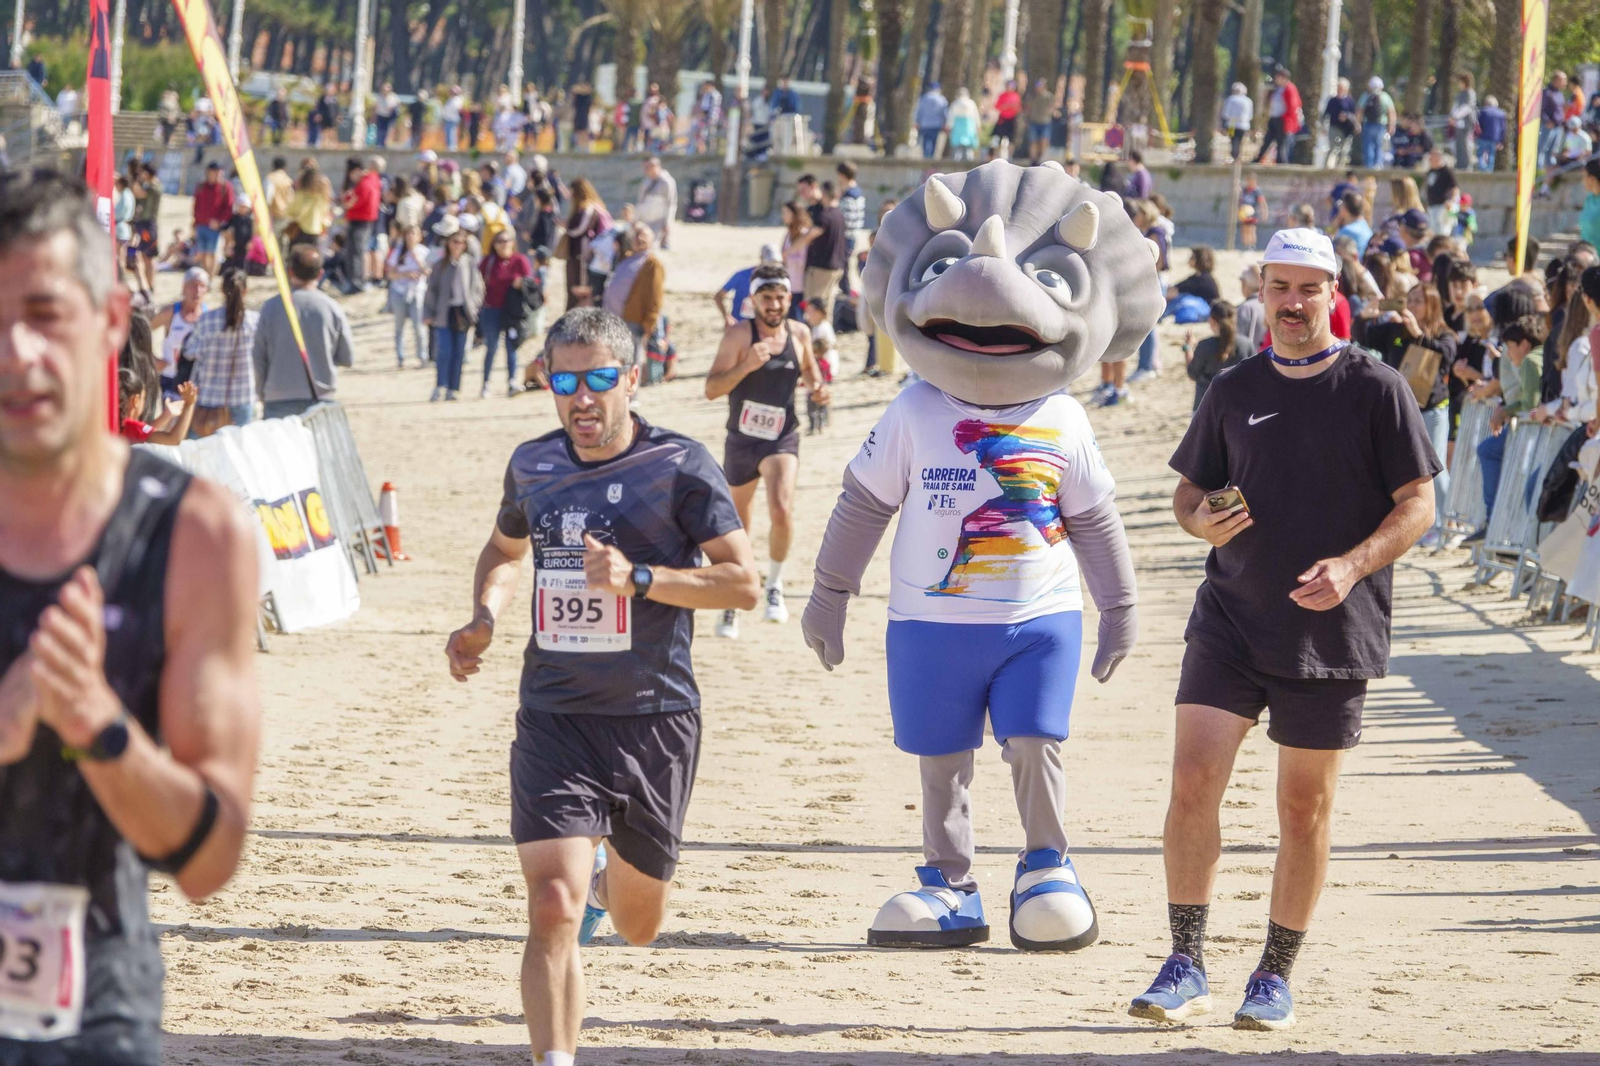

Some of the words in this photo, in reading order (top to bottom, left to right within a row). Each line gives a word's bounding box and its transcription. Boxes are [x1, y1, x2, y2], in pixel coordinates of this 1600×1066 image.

[1282, 243, 1313, 253] BROOKS
[751, 414, 774, 428] 430
[921, 468, 977, 482] CARREIRA
[923, 482, 940, 490] PRAIA
[940, 482, 950, 491] DE
[951, 482, 976, 491] SAMIL
[933, 509, 962, 518] seguros
[551, 596, 603, 624] 395
